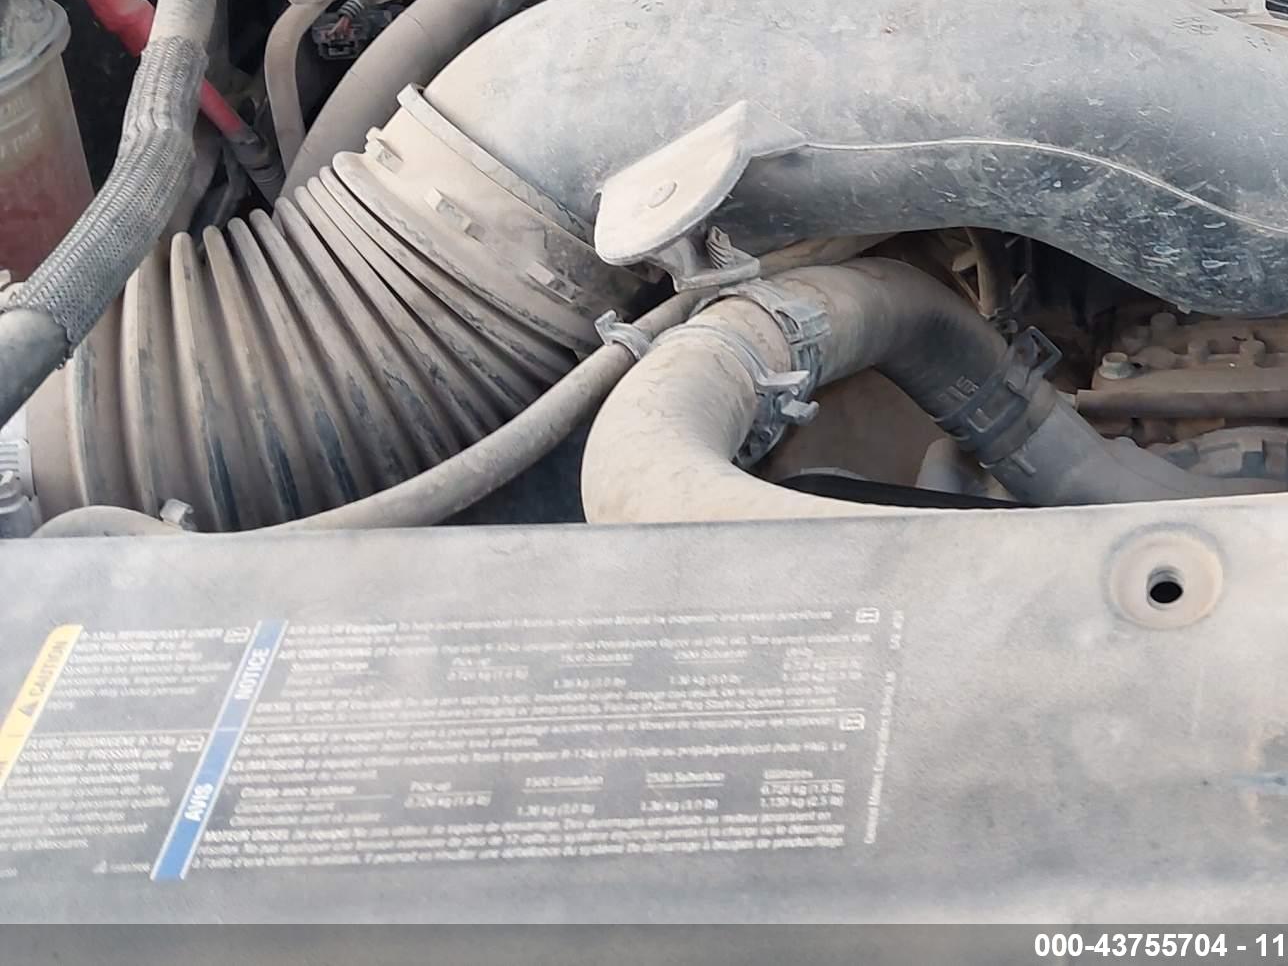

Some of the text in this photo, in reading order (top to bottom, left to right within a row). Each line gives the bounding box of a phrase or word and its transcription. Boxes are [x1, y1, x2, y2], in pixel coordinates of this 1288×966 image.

[29, 641, 68, 696] CAUTION
[234, 648, 270, 701] NOTICE
[185, 784, 214, 821] AVIS
